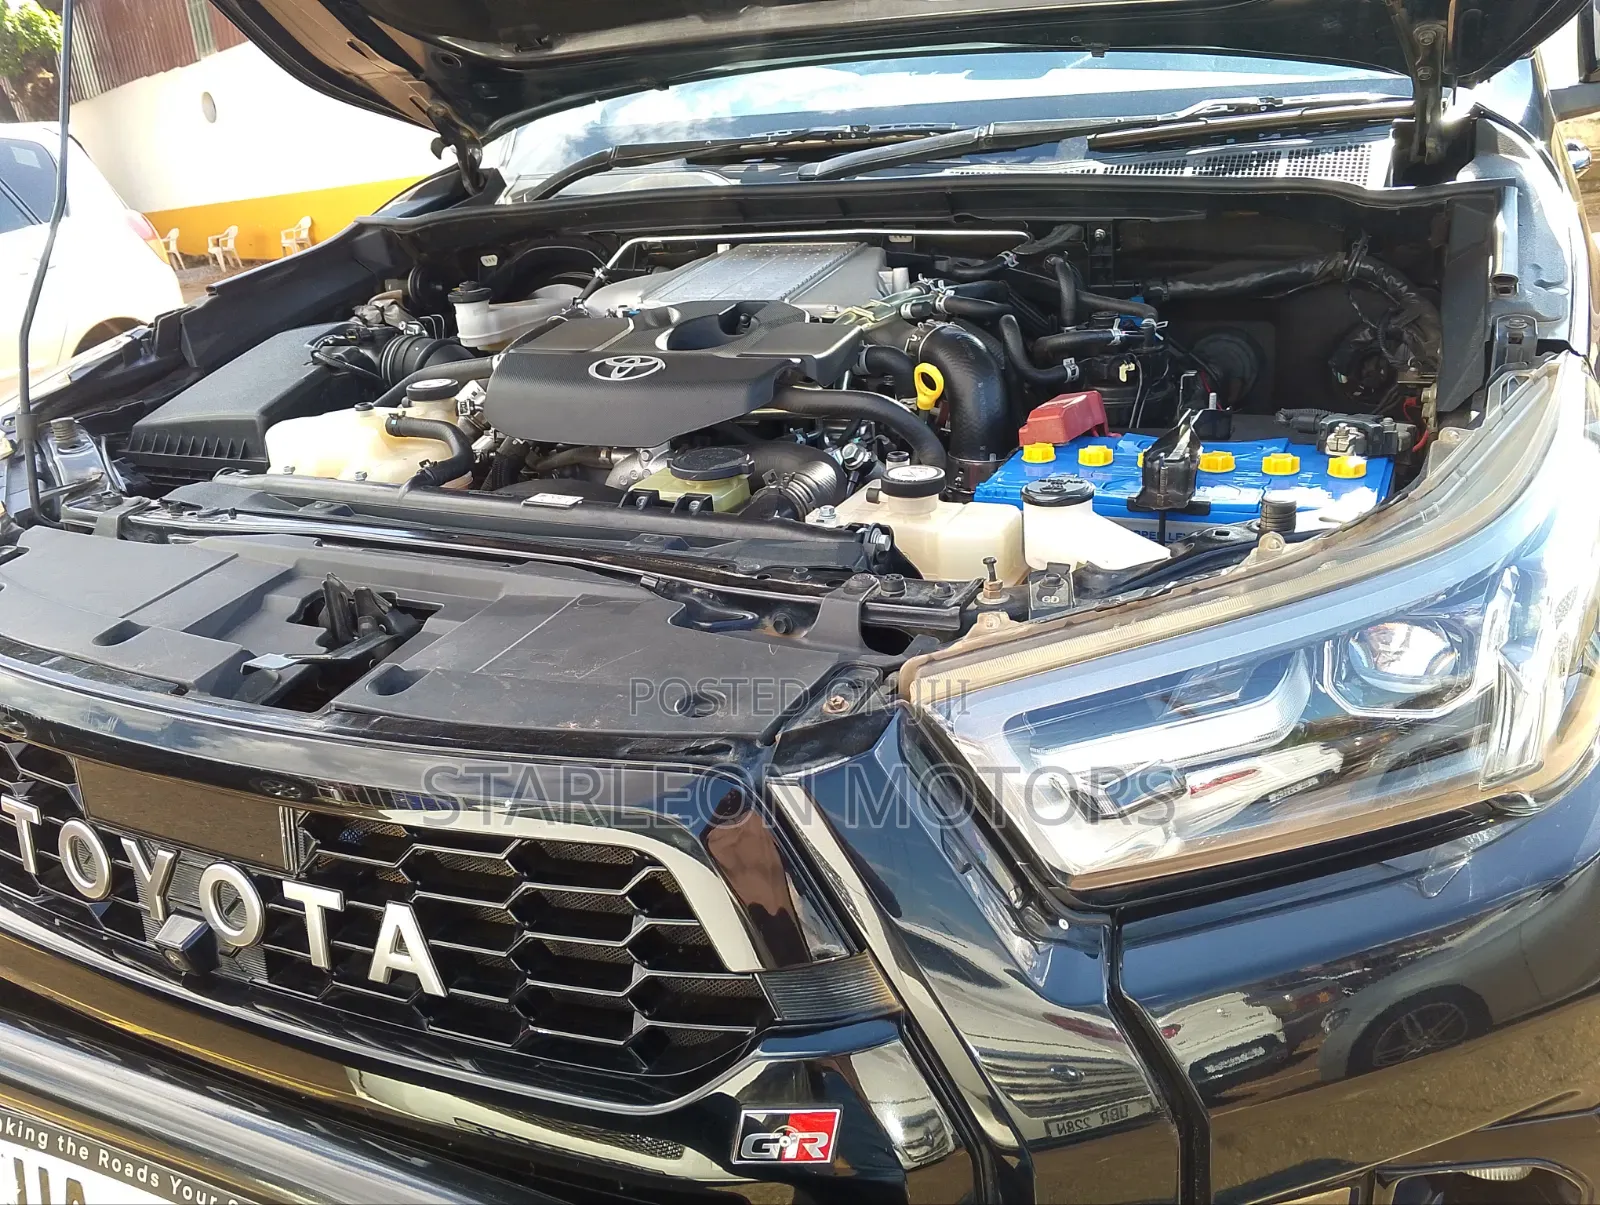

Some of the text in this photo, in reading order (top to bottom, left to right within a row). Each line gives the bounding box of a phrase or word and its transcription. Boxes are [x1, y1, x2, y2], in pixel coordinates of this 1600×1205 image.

[0, 793, 449, 998] TOYOTA
[57, 1135, 90, 1161] the
[98, 1149, 159, 1188] Roads
[170, 1175, 217, 1204] Your
[740, 1131, 829, 1160] GR
